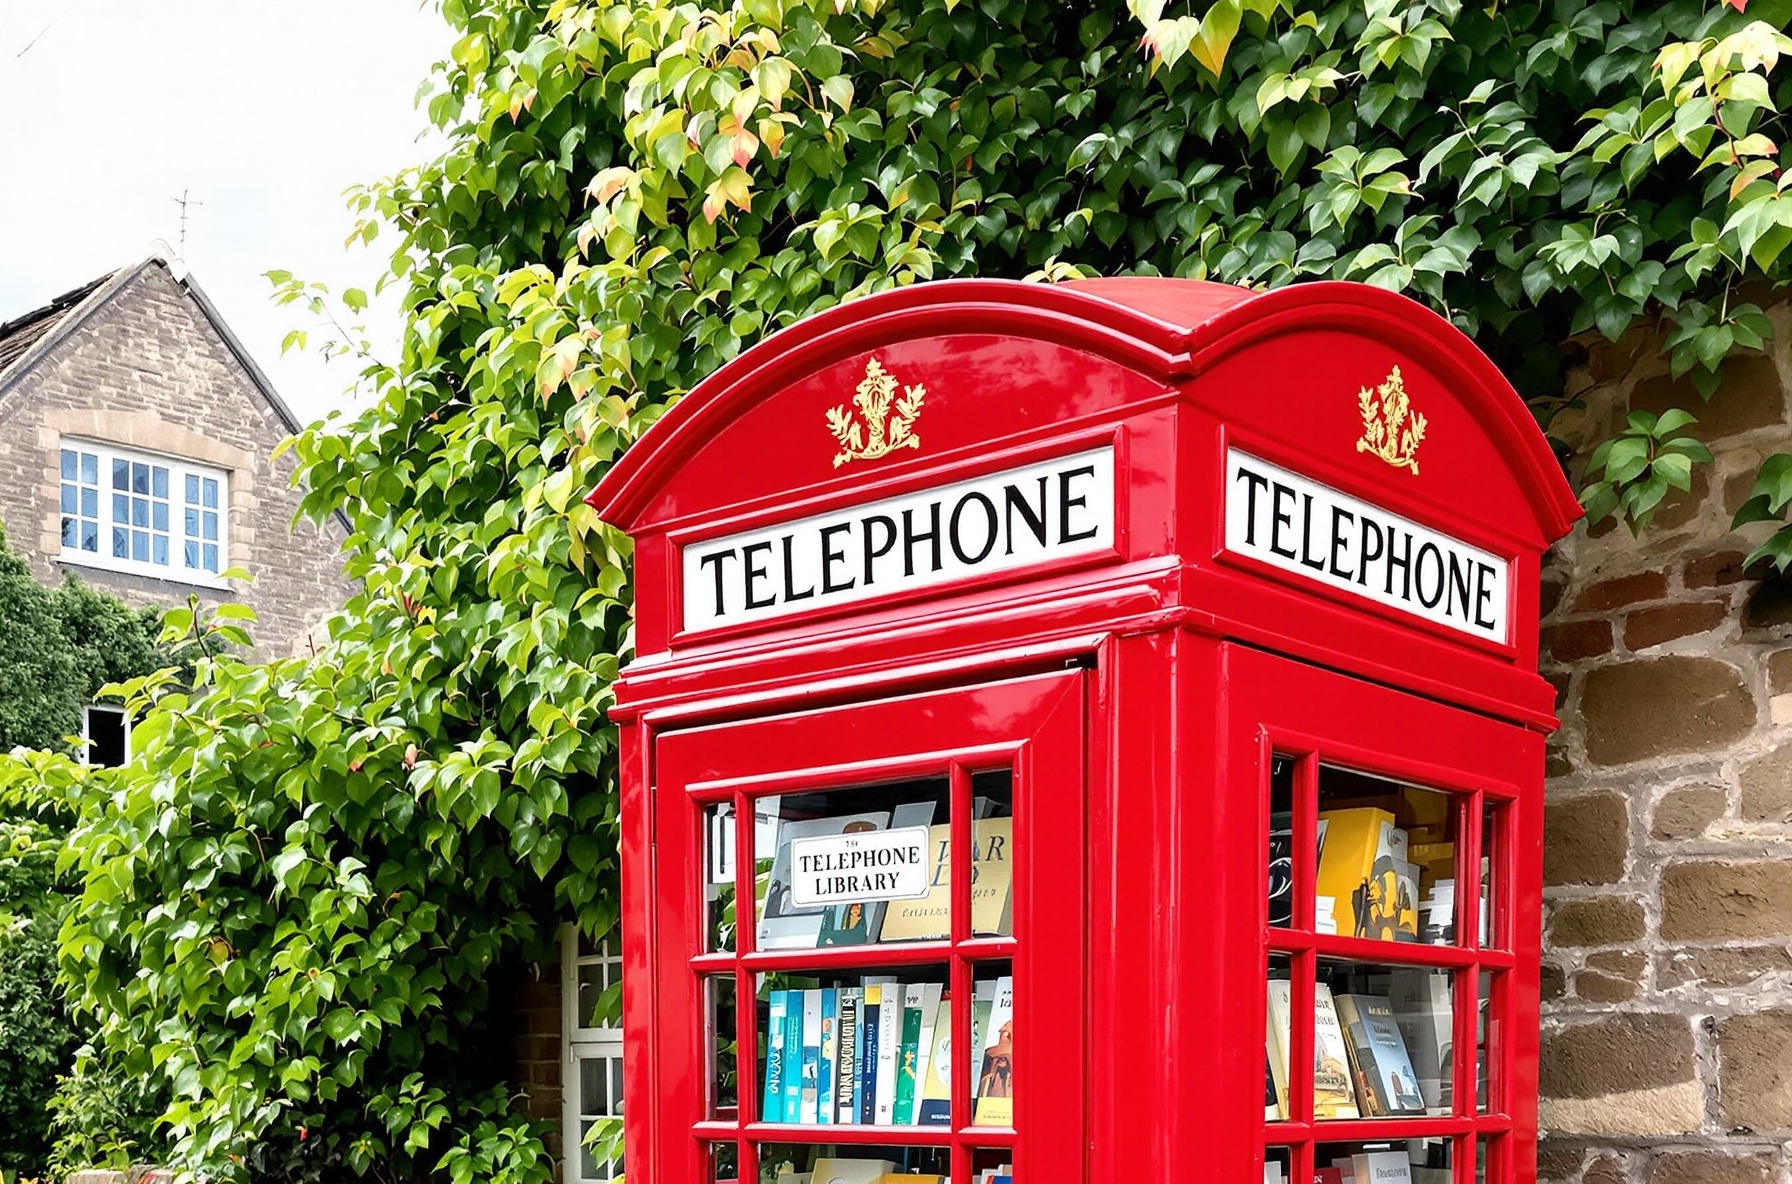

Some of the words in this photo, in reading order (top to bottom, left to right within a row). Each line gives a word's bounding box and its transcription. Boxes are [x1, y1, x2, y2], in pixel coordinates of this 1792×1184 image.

[701, 466, 1099, 616] TELEPHONE
[1236, 466, 1497, 631] TELEPHONE
[800, 846, 920, 873] TELEPHONE
[815, 871, 900, 896] LIBRARY
